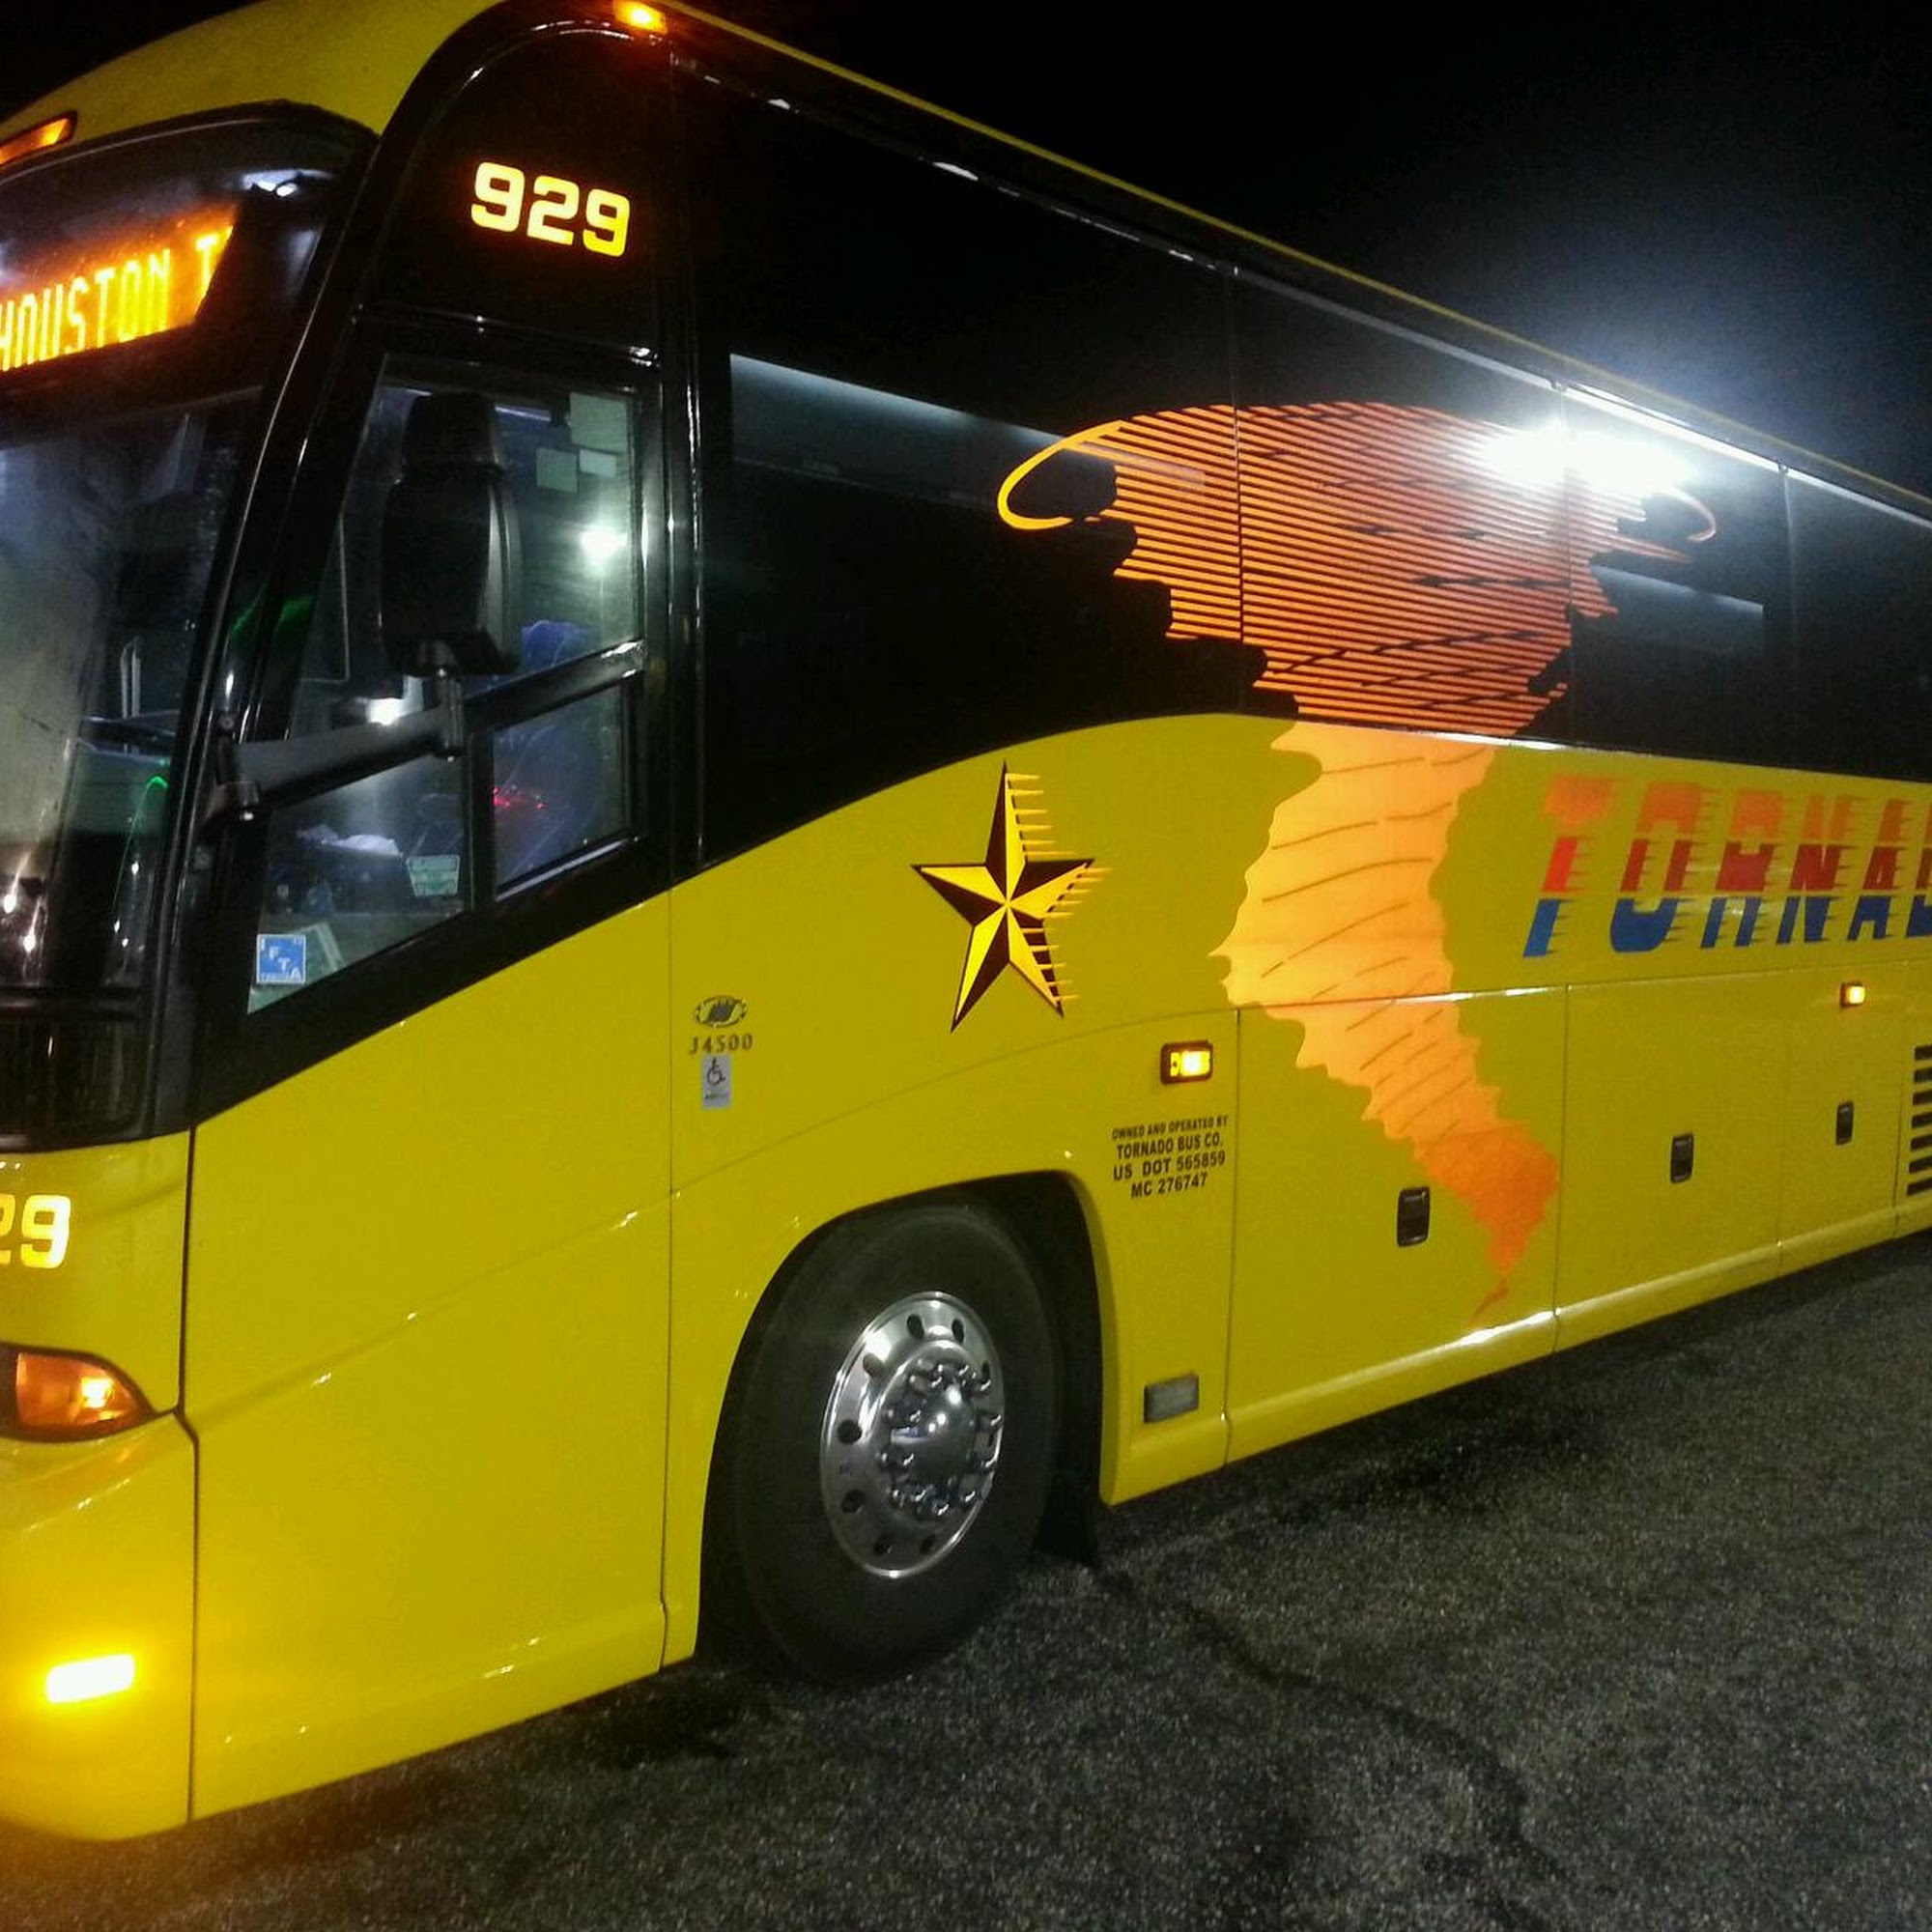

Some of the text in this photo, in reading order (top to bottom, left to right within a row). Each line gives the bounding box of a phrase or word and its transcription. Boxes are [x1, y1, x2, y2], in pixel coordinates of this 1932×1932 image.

[471, 162, 630, 257] 929
[0, 248, 170, 372] HOUSTON
[690, 1034, 753, 1055] J4500
[1112, 1116, 1228, 1140] OWNED AND OPERATED BY
[1117, 1138, 1174, 1160] TORNADO
[1178, 1134, 1201, 1151] BUS
[1113, 1151, 1226, 1181] US DOT 565859
[1131, 1172, 1208, 1198] MC 276747
